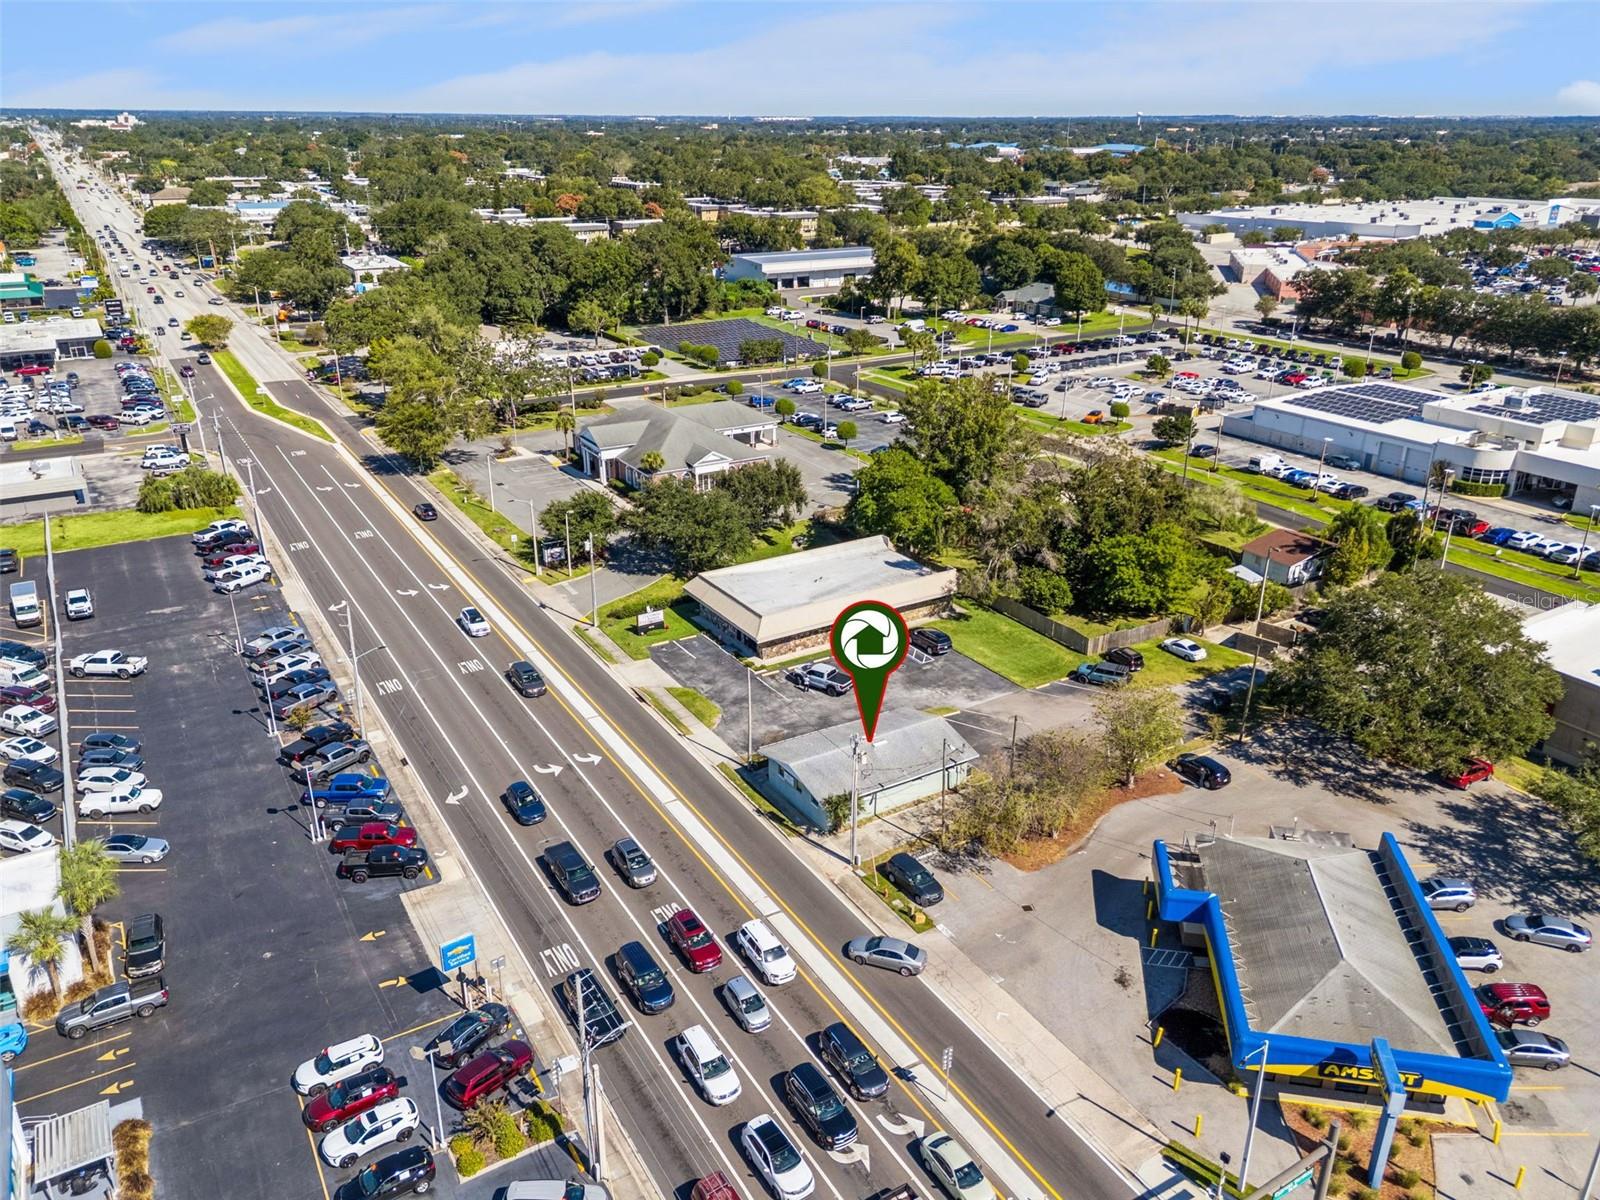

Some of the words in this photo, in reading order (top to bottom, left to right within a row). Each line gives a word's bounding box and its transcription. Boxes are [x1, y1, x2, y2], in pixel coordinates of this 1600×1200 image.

[457, 659, 483, 674] ONLY
[376, 679, 402, 695] ONLY
[539, 943, 580, 977] ONLY
